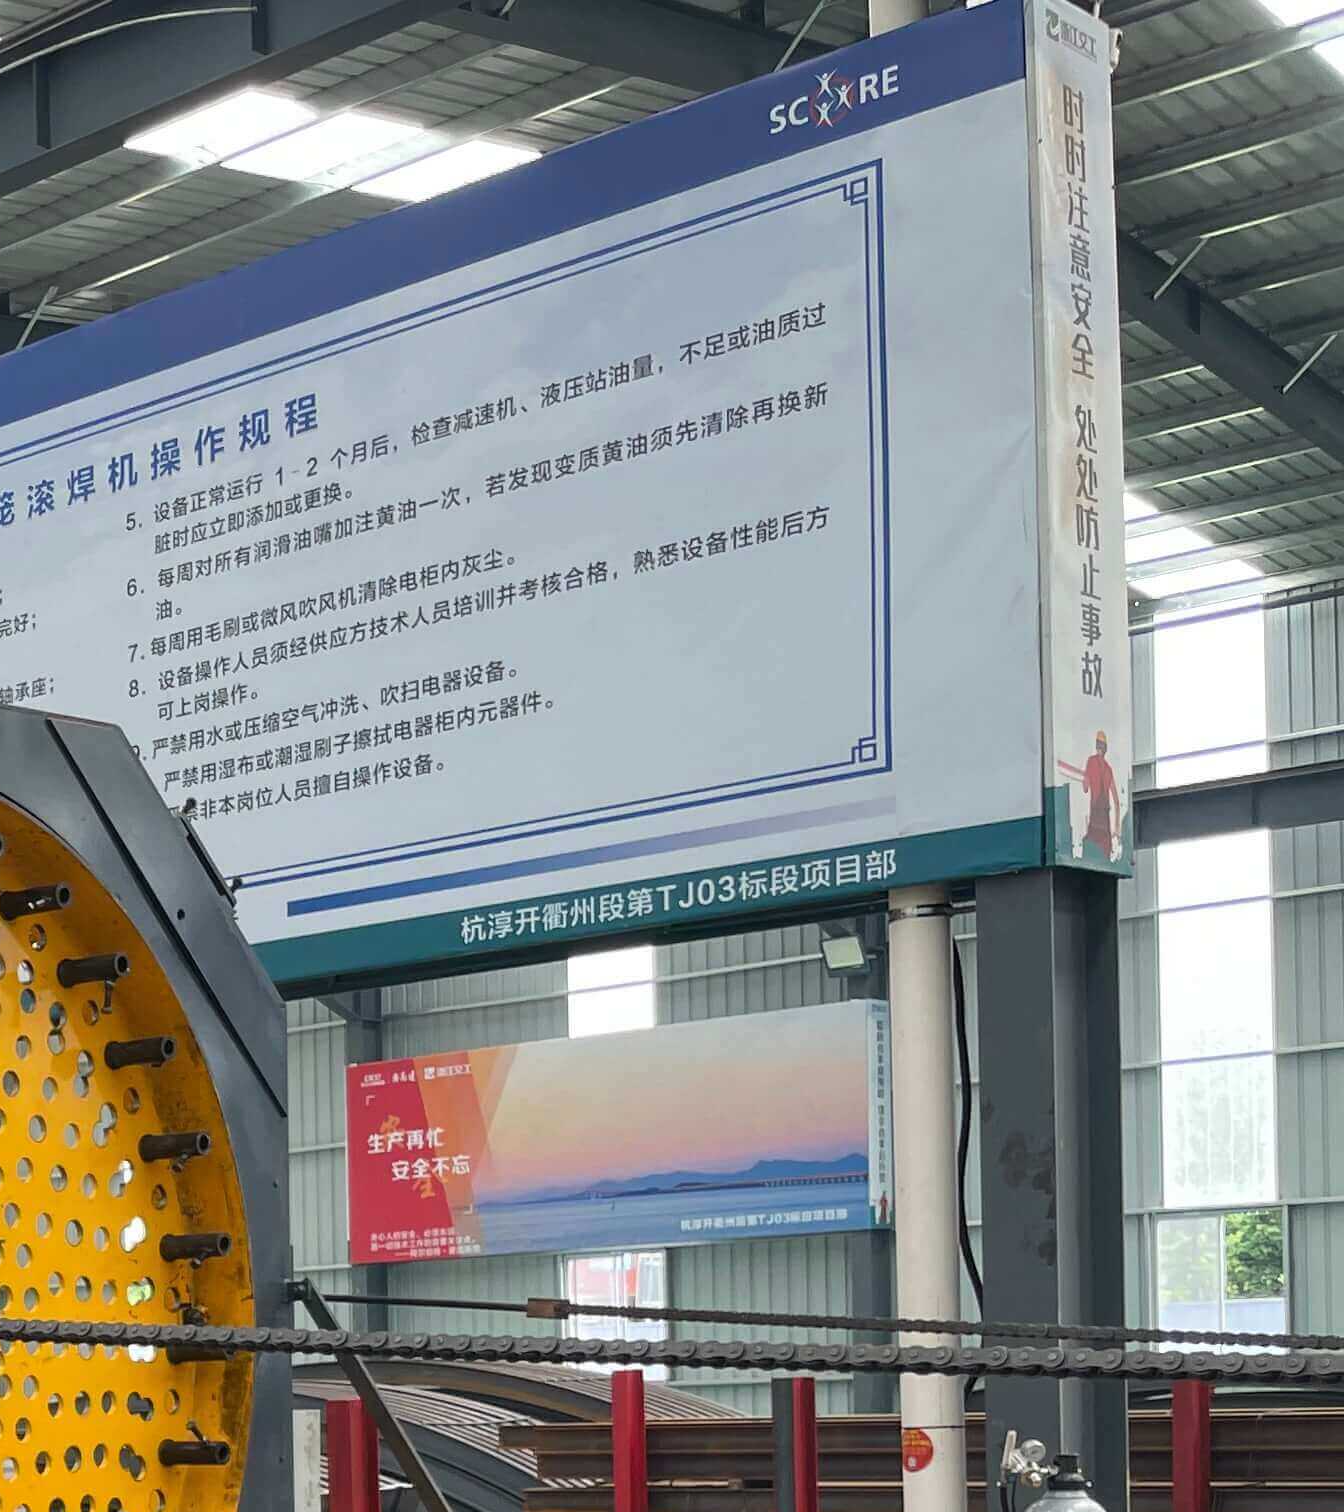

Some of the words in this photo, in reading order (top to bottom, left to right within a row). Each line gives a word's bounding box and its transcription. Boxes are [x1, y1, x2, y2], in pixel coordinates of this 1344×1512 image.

[1063, 84, 1095, 380] 时时注意安全
[154, 472, 263, 524] 设备正常运行
[154, 482, 353, 555] 脏时应立即添加或更换。
[1074, 404, 1104, 699] 处处防止事故
[155, 599, 183, 622] 油。
[157, 683, 259, 722] 可上岗操作。
[460, 848, 897, 946] 杭淳开衢州段第TJ03标段项目部
[367, 1127, 446, 1154] 生产再忙
[390, 1154, 472, 1181] 安全不忘
